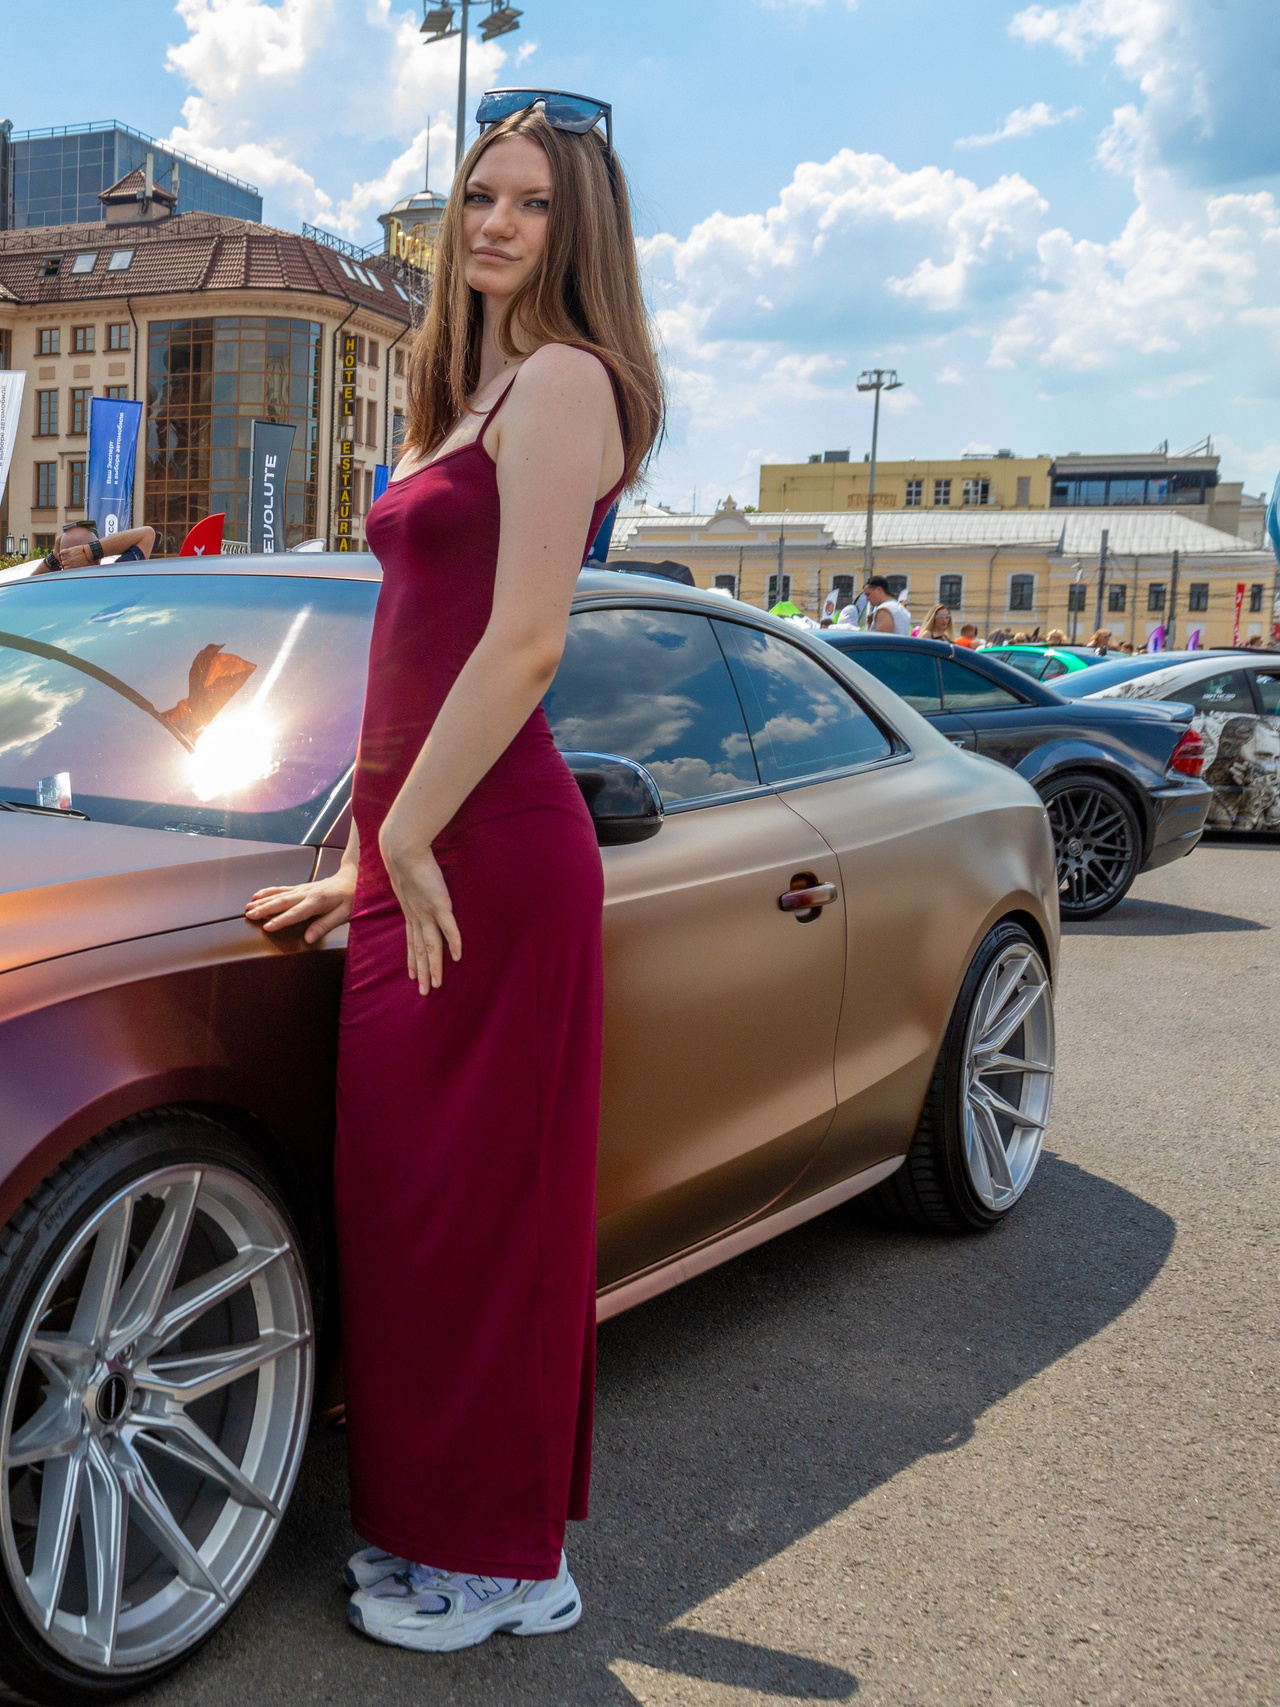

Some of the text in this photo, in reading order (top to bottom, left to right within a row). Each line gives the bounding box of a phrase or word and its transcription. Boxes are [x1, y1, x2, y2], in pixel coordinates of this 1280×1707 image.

[344, 339, 356, 415] HOTEL
[117, 412, 125, 453] автомобиля
[263, 454, 277, 553] EVOLUTE
